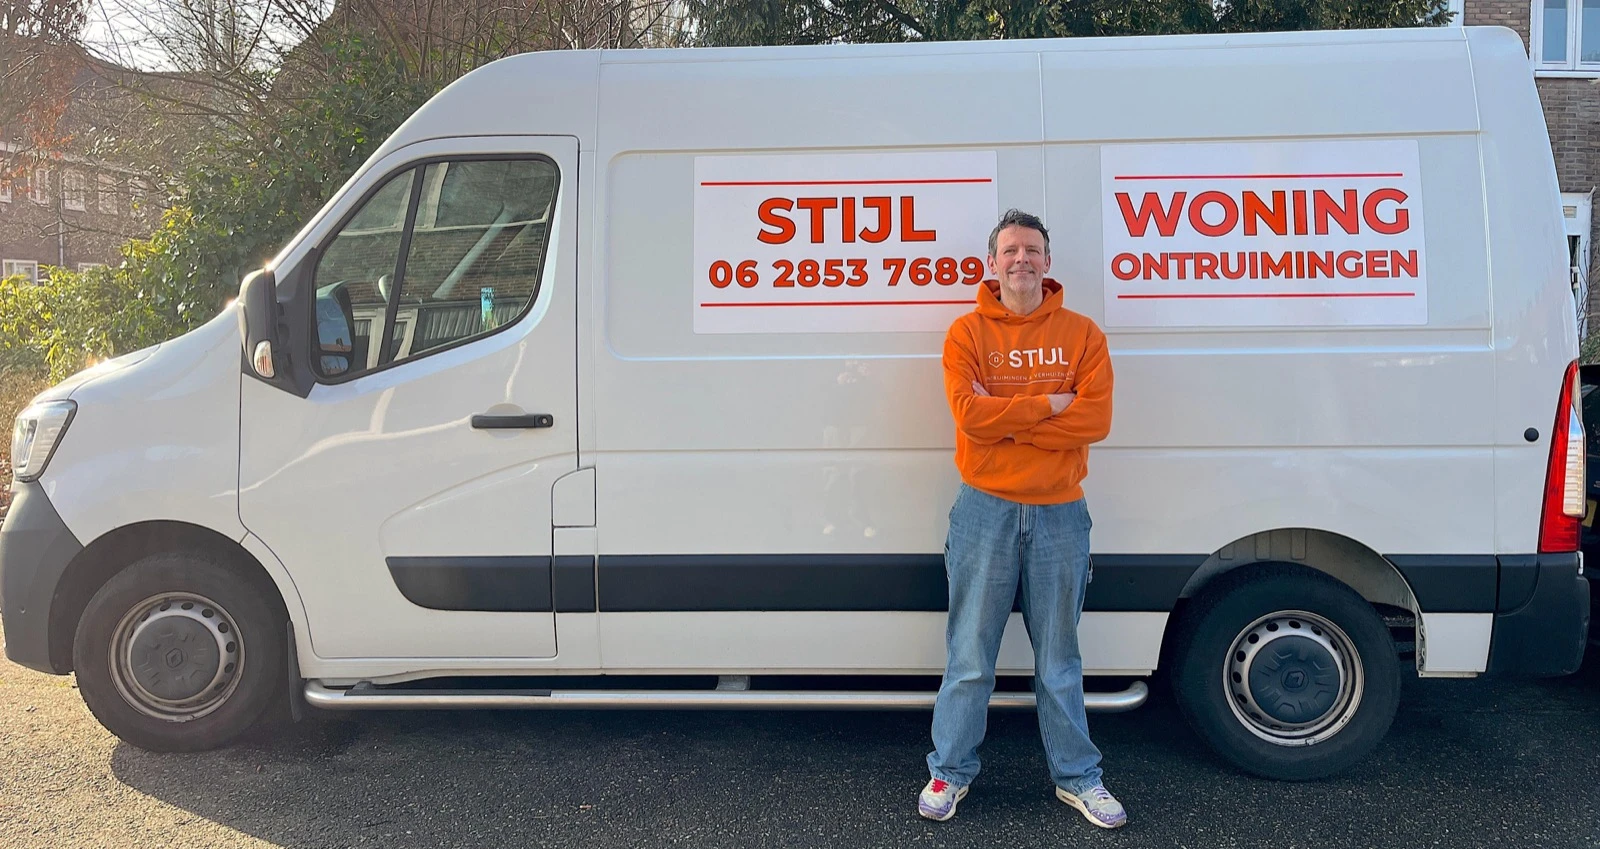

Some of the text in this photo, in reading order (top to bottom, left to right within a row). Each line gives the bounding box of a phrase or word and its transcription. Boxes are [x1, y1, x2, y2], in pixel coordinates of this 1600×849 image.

[757, 196, 937, 245] STIJL
[1114, 188, 1410, 237] WONING
[708, 256, 985, 288] 06 2853 7689
[1111, 249, 1418, 281] ONTRUIMINGEN
[1008, 347, 1069, 368] STIJL
